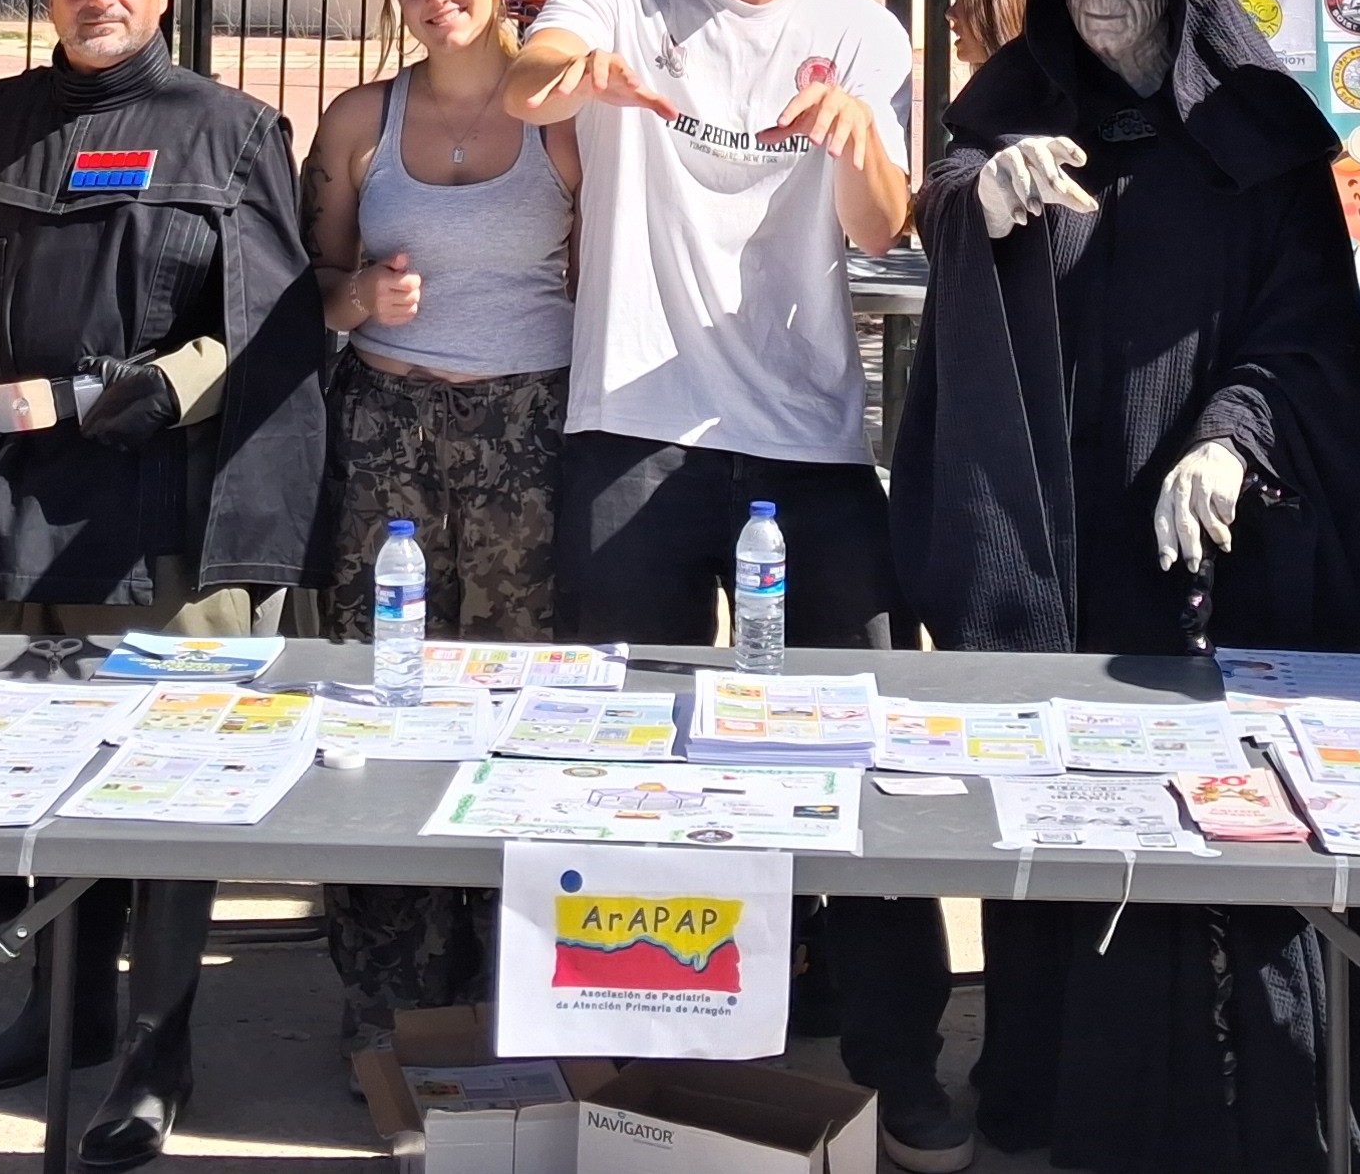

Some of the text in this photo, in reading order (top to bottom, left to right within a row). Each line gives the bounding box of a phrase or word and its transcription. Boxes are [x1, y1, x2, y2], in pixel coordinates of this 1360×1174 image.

[700, 123, 751, 151] RHINO
[581, 905, 719, 936] ArAPAP
[573, 1000, 622, 1012] Atención
[625, 1003, 672, 1014] Primaria
[675, 1005, 688, 1014] de
[692, 1004, 732, 1017] Aragón
[580, 989, 641, 1001] Asociación
[644, 991, 658, 1001] de
[588, 1110, 674, 1145] NAVIGATOR
